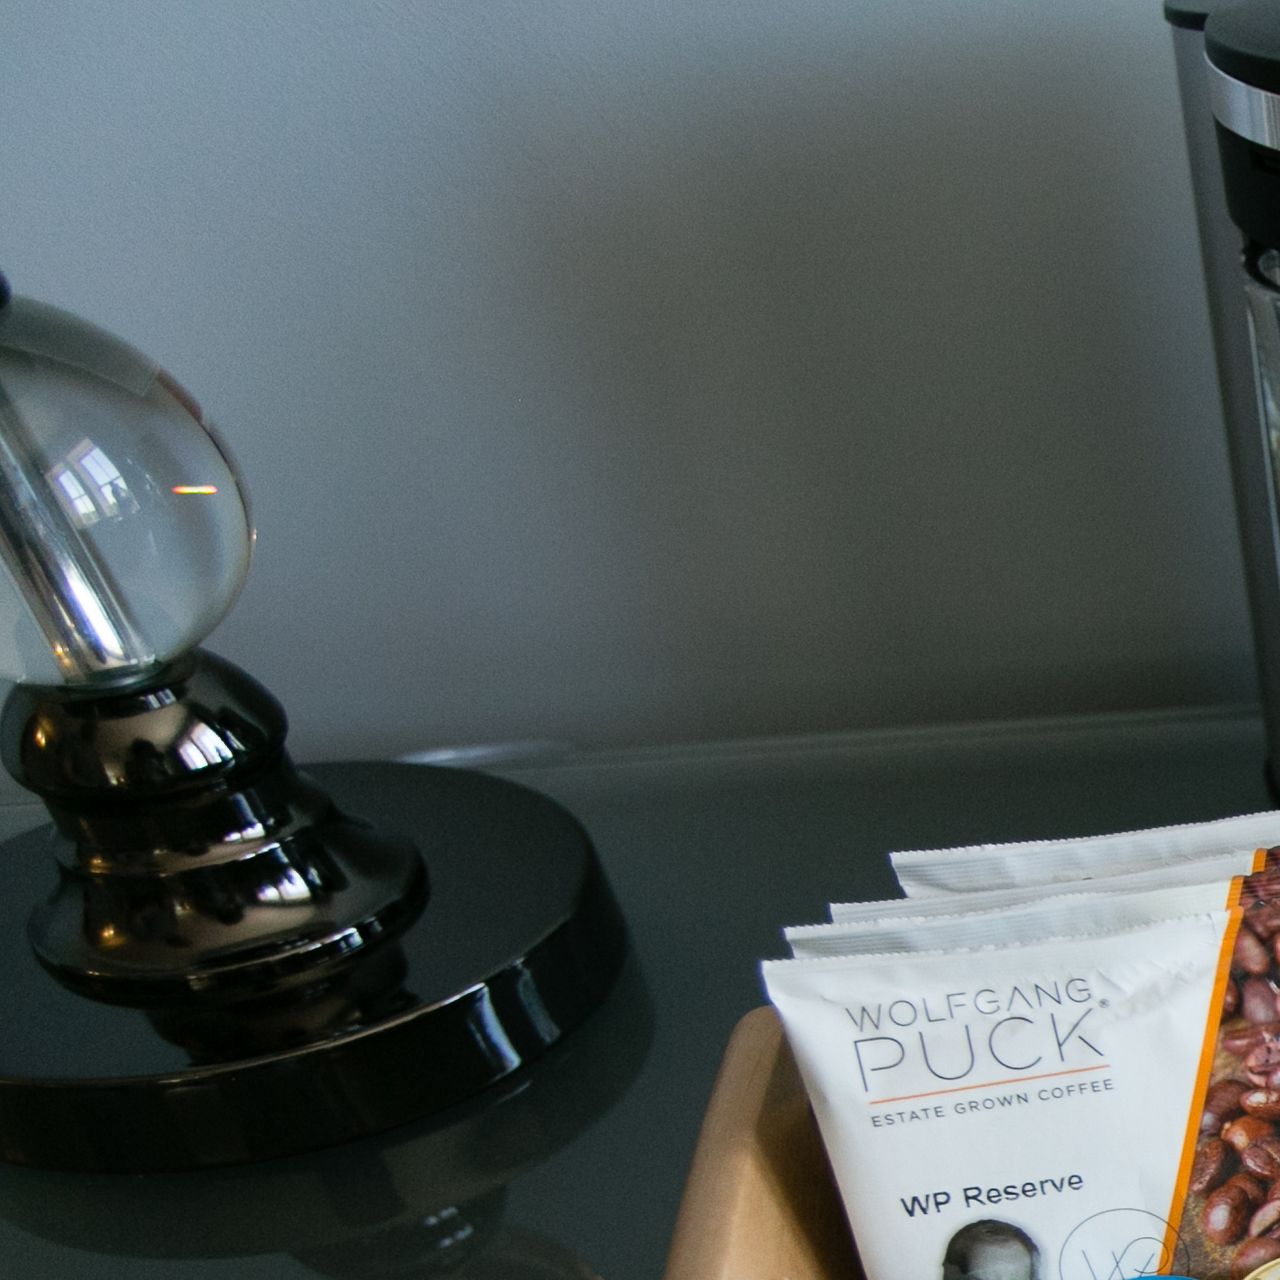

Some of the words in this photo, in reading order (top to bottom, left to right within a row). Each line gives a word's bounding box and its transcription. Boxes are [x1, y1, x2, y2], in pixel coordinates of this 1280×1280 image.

[846, 978, 1091, 1032] WOLFGANG
[854, 1008, 1104, 1092] PUCK
[871, 1106, 945, 1127] ESTATE
[954, 1092, 1029, 1116] GROWN
[1038, 1079, 1114, 1101] COFFEE
[901, 1191, 951, 1217] WP
[963, 1174, 1084, 1208] Reserve
